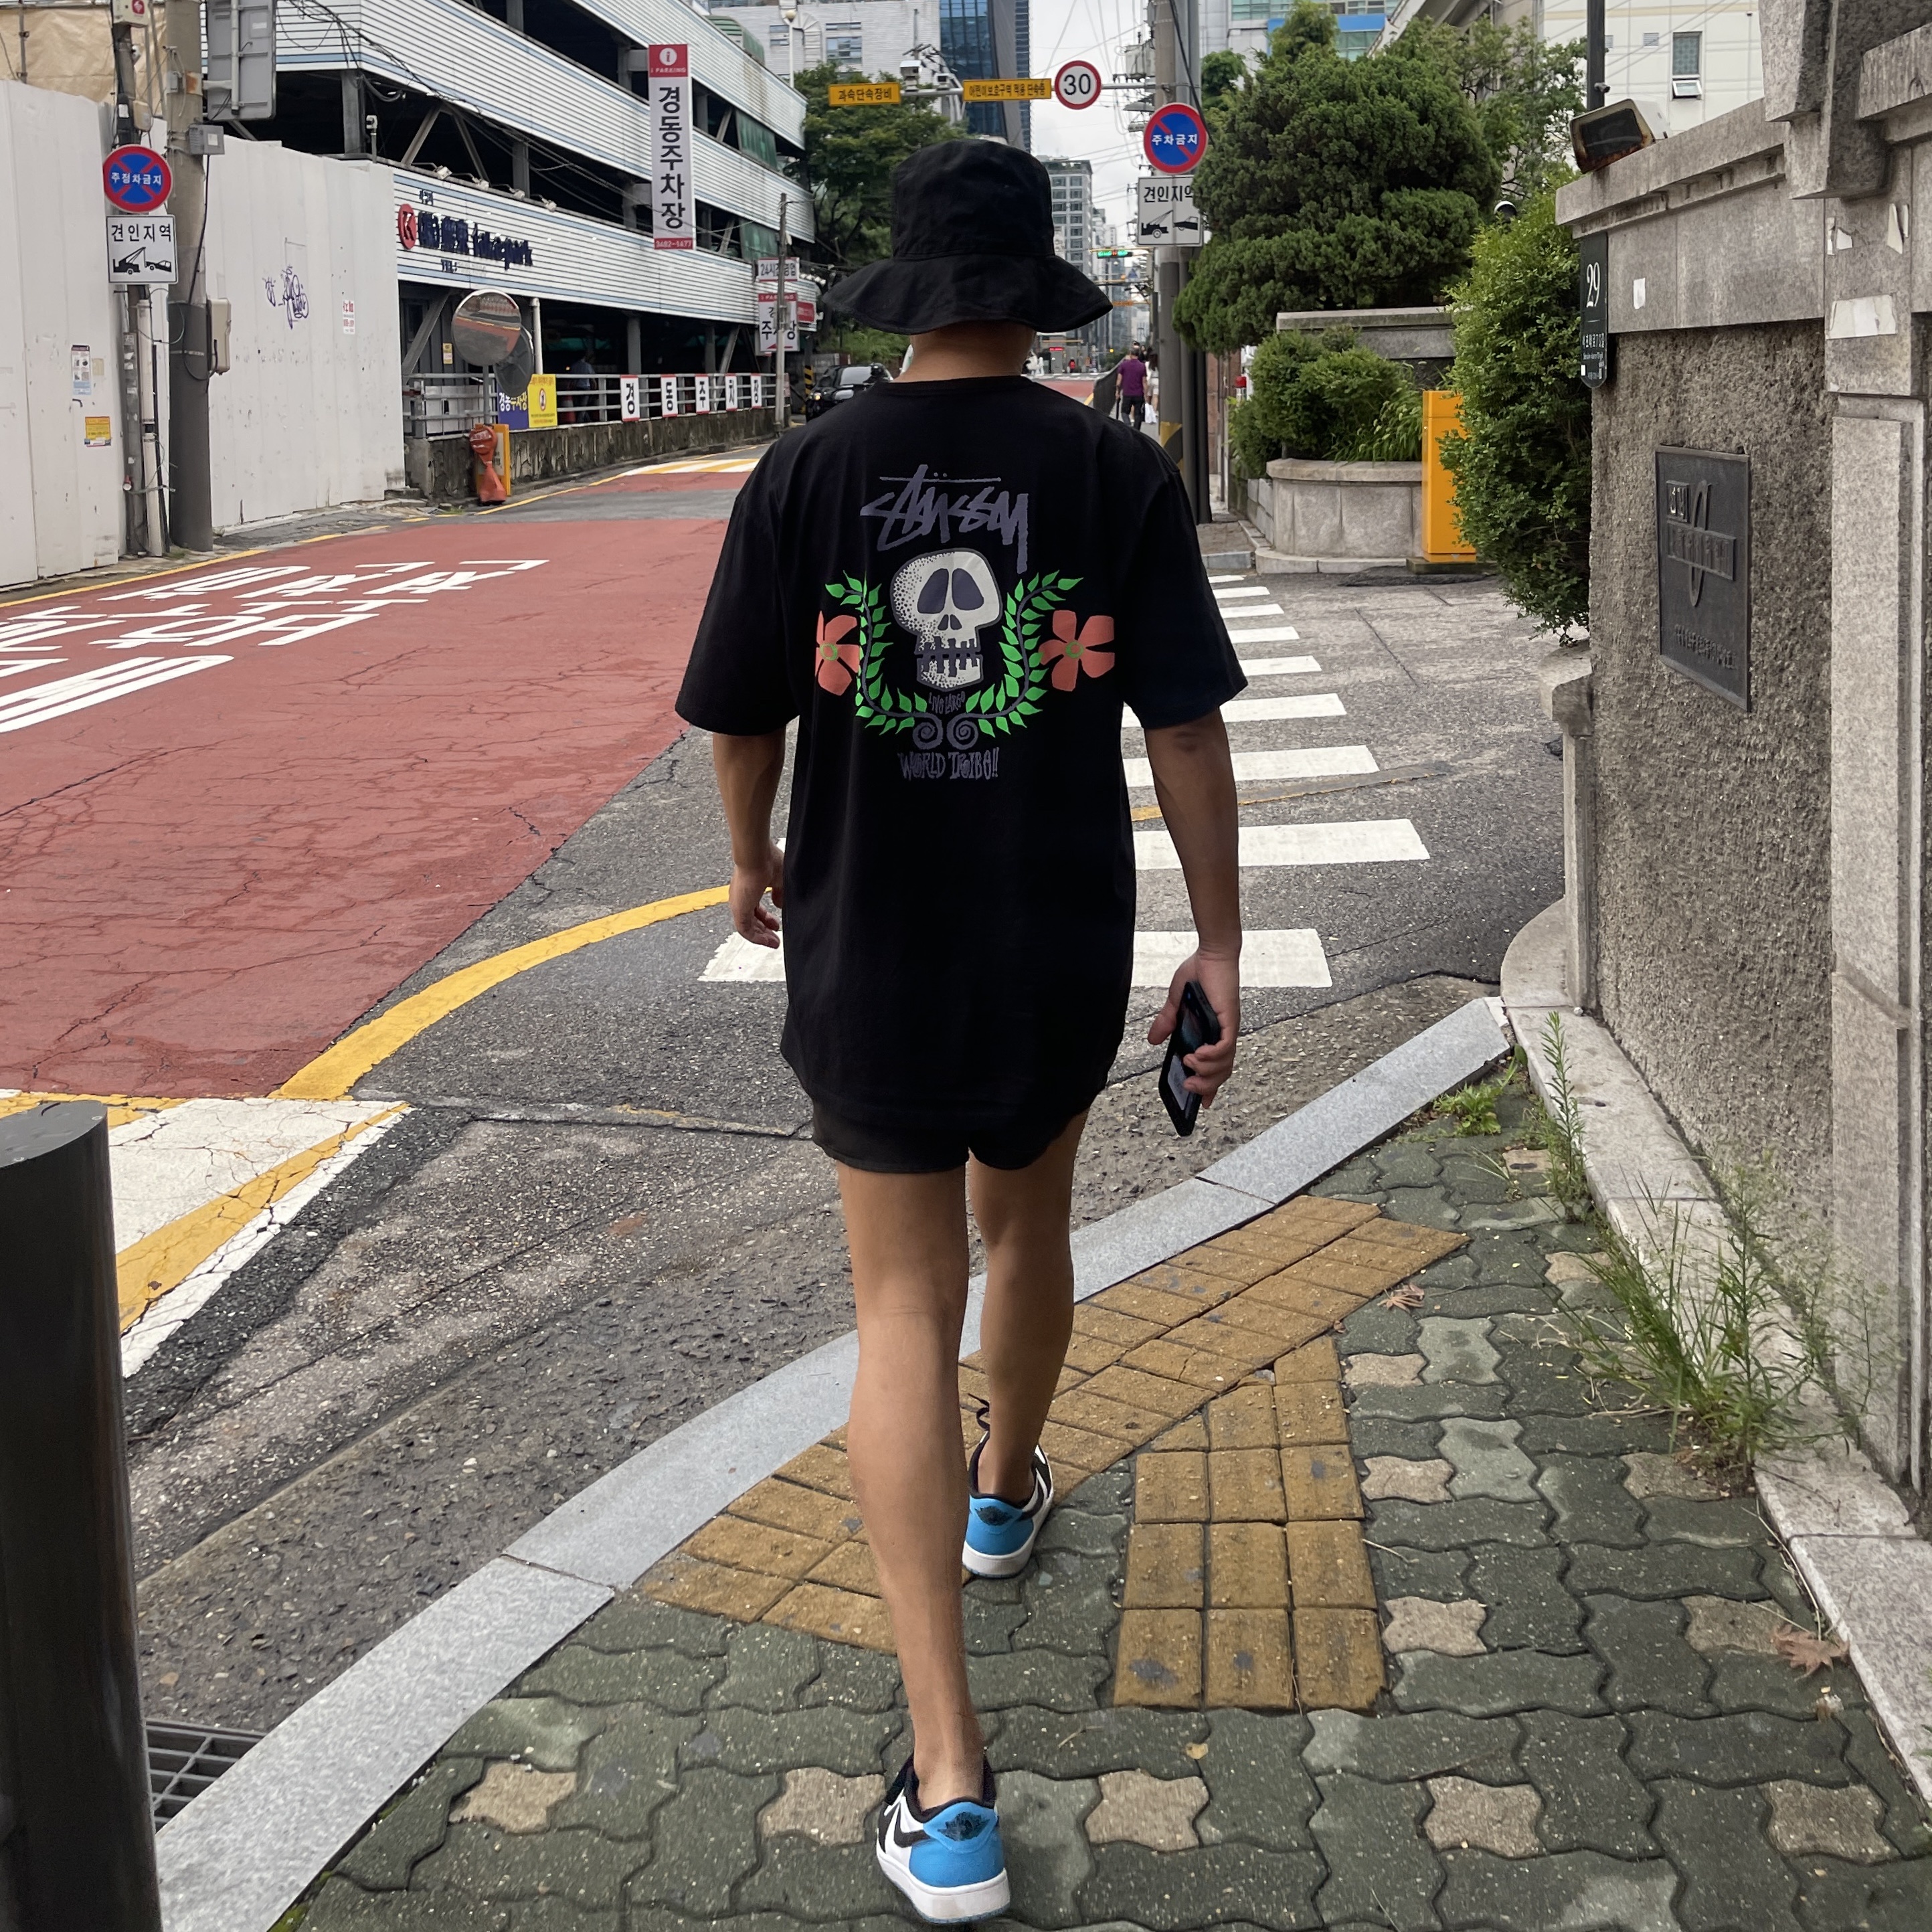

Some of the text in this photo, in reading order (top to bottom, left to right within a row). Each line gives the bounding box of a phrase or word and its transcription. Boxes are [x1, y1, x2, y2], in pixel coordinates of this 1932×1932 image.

[1064, 73, 1091, 95] 30
[839, 88, 892, 102] 과속단속장비
[1152, 134, 1198, 145] 주차금지
[658, 86, 685, 229] 경동주차장
[111, 172, 162, 185] 주정차금지
[111, 224, 171, 242] 견인지역
[1586, 262, 1600, 308] 29
[897, 751, 946, 781] WORLD
